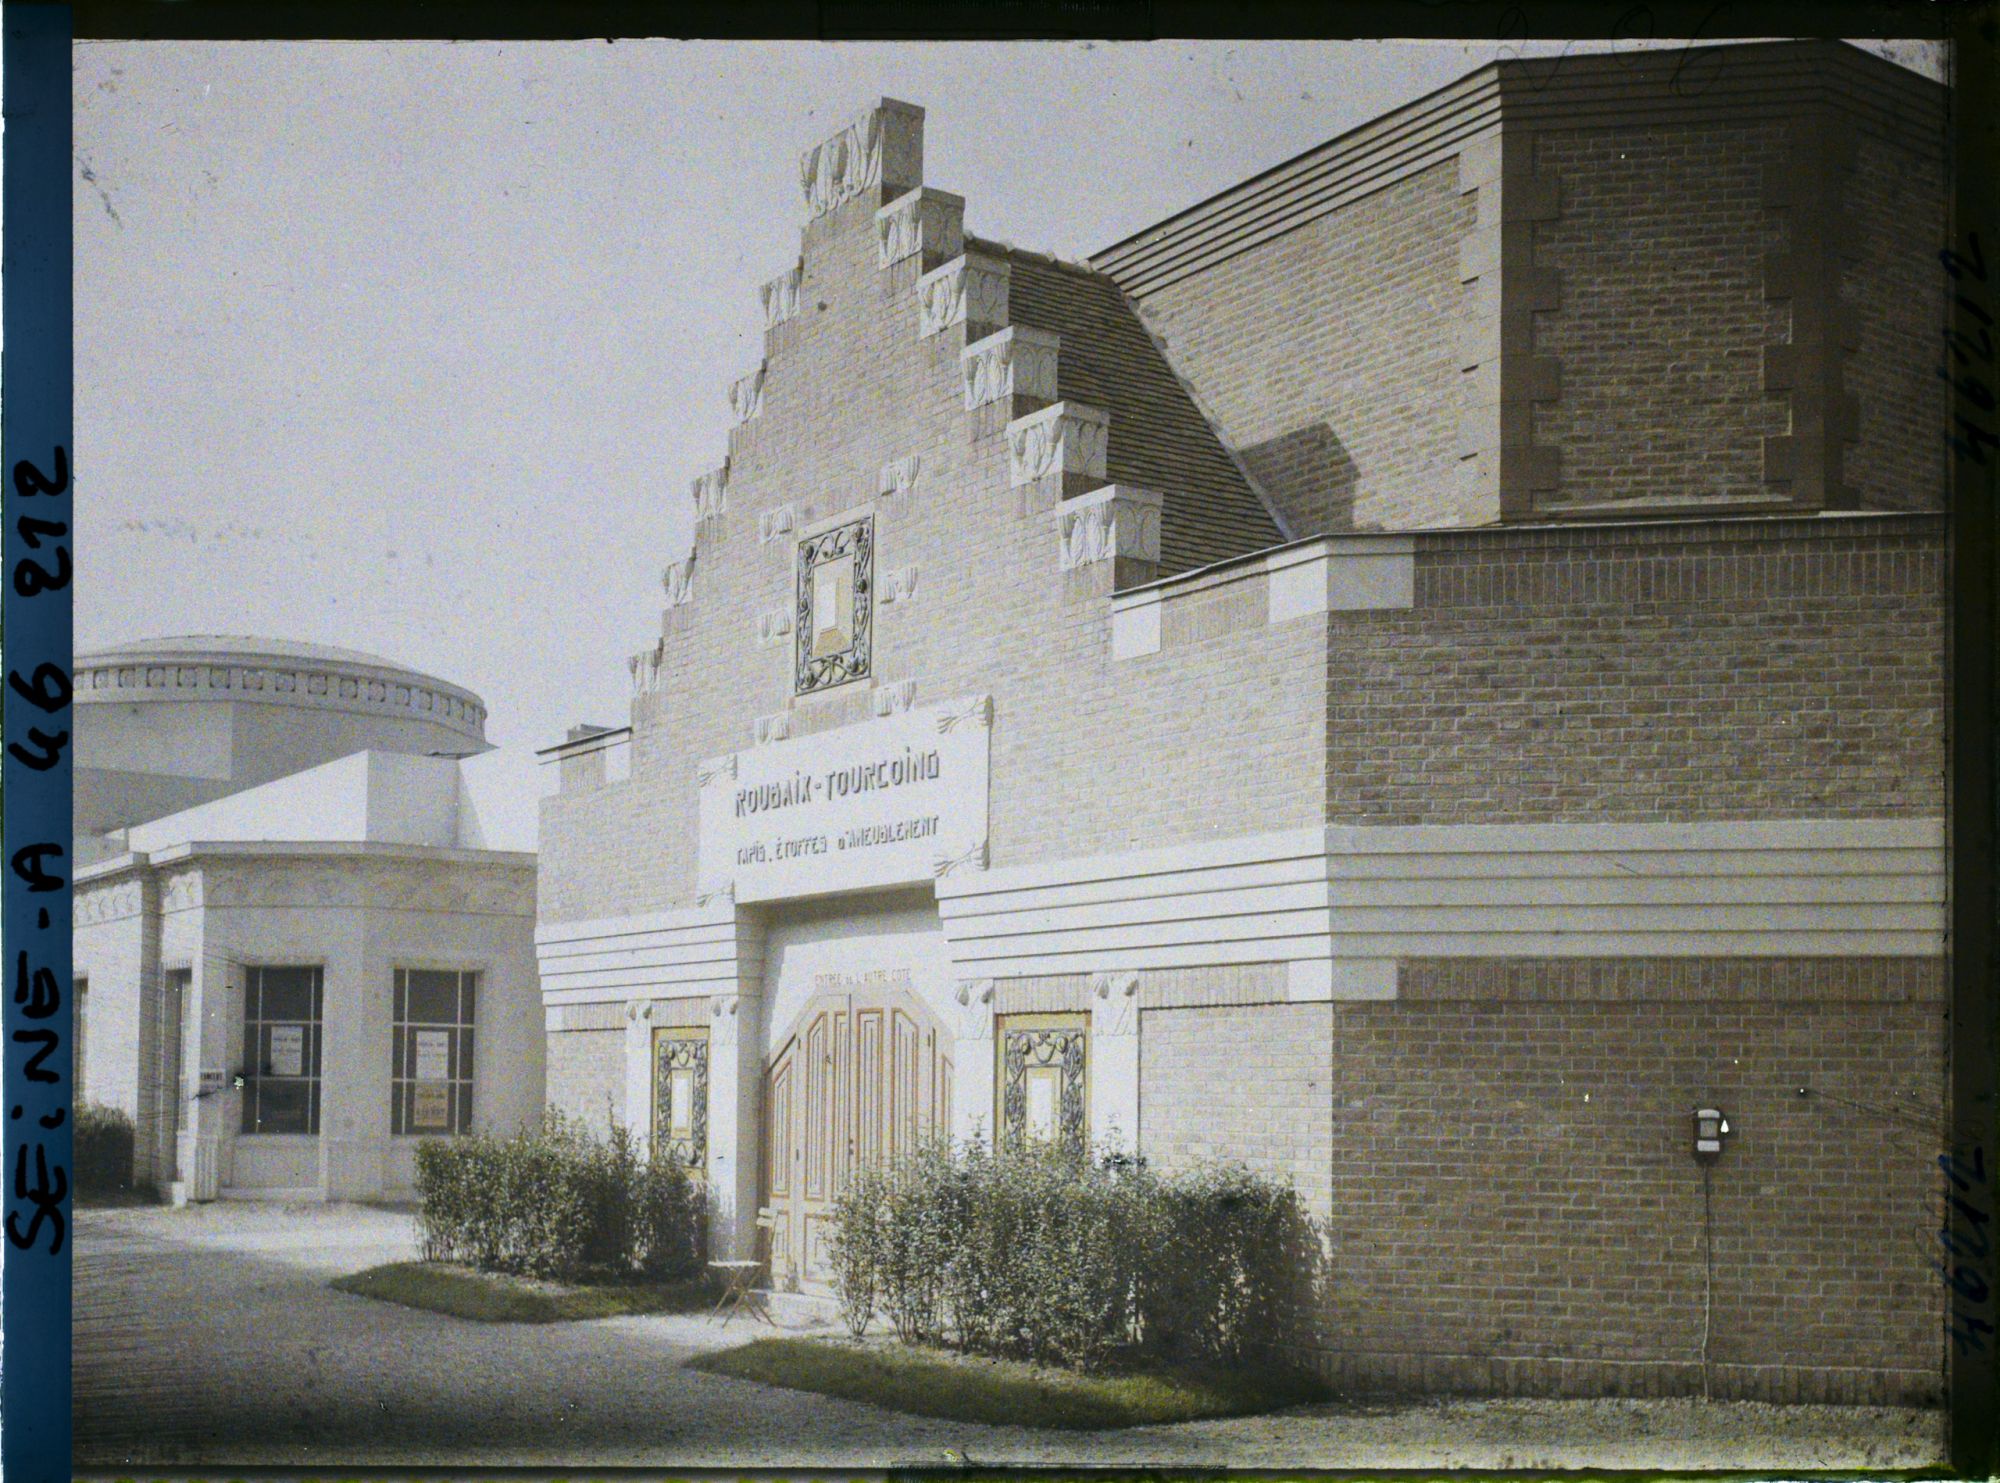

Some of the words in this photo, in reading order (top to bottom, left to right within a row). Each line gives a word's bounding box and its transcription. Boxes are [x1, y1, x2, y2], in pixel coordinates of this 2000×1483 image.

[13, 446, 72, 598] 212
[6, 661, 71, 770] 46
[776, 835, 827, 860] ÉTOFFES
